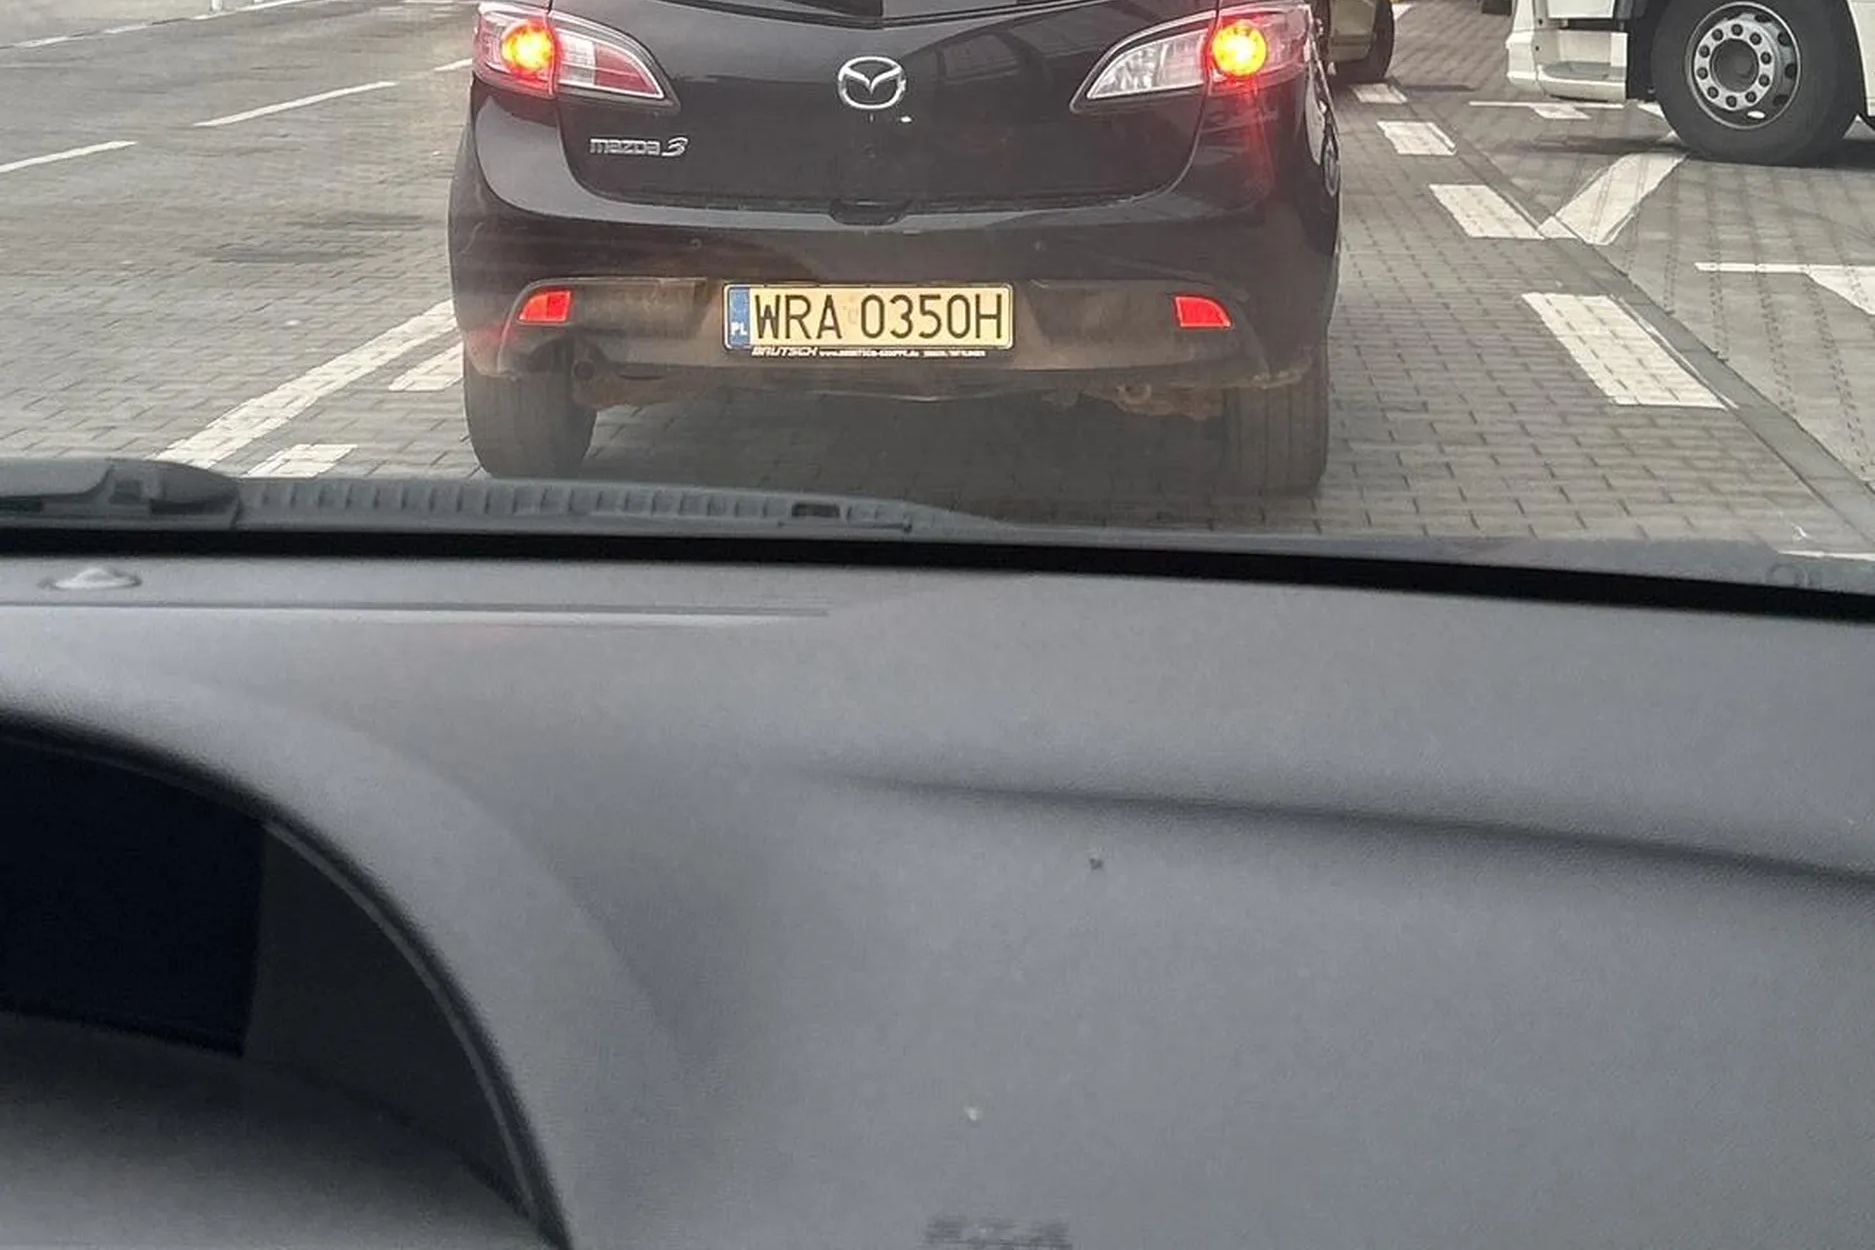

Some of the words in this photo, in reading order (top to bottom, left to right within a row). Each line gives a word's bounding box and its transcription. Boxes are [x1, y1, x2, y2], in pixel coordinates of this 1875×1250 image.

[731, 322, 747, 336] PL
[754, 294, 842, 340] WRA
[860, 293, 1003, 340] 0350H
